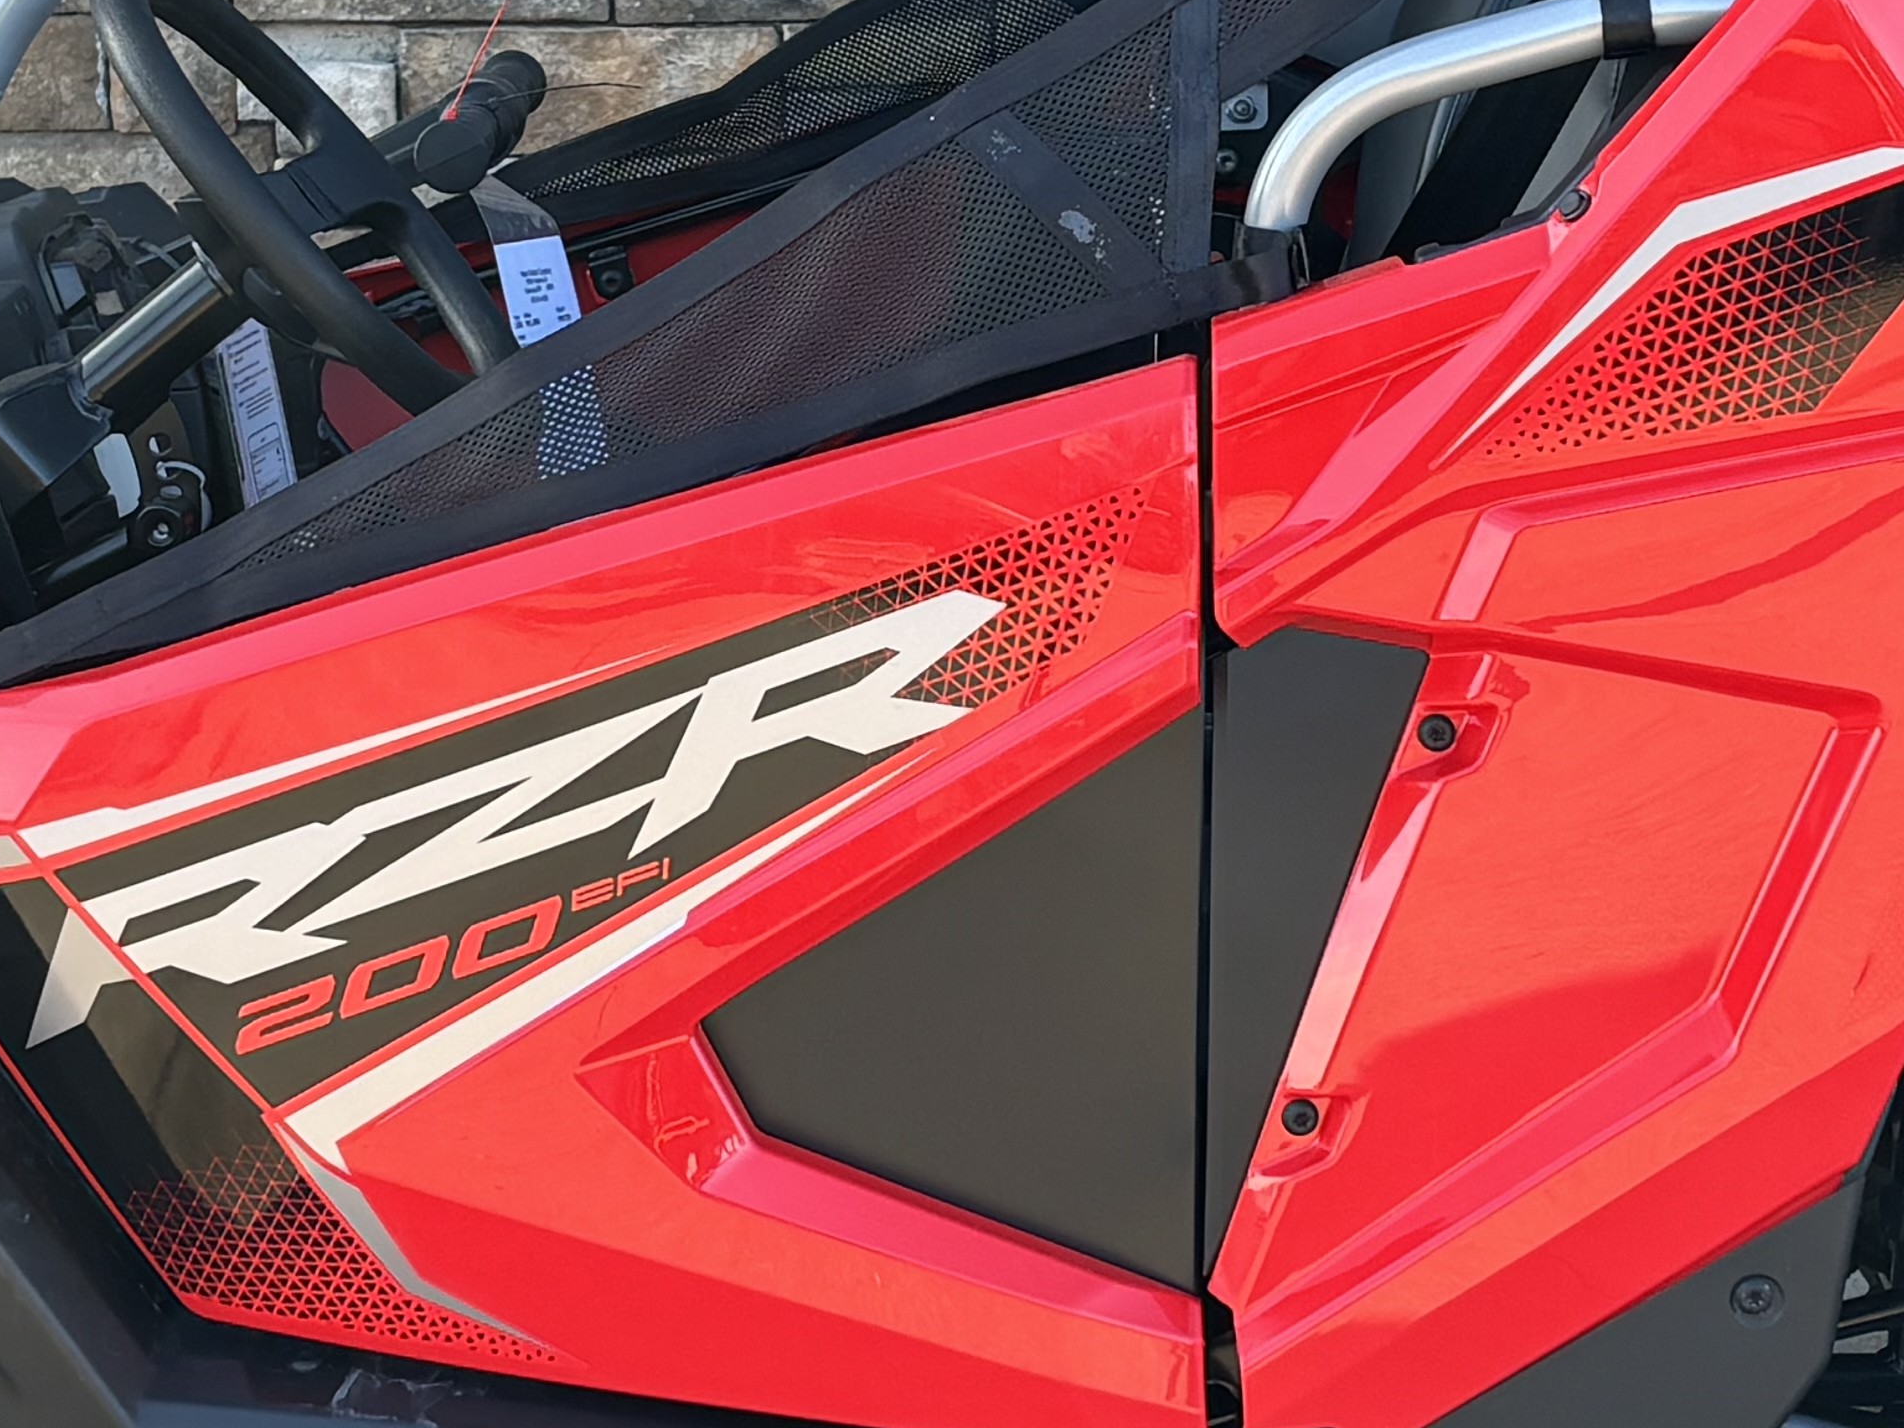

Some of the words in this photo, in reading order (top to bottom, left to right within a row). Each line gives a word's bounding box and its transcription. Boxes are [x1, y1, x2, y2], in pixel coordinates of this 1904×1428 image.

[25, 589, 1007, 1049] RZR
[235, 896, 565, 1054] 200
[571, 856, 672, 908] EFI
